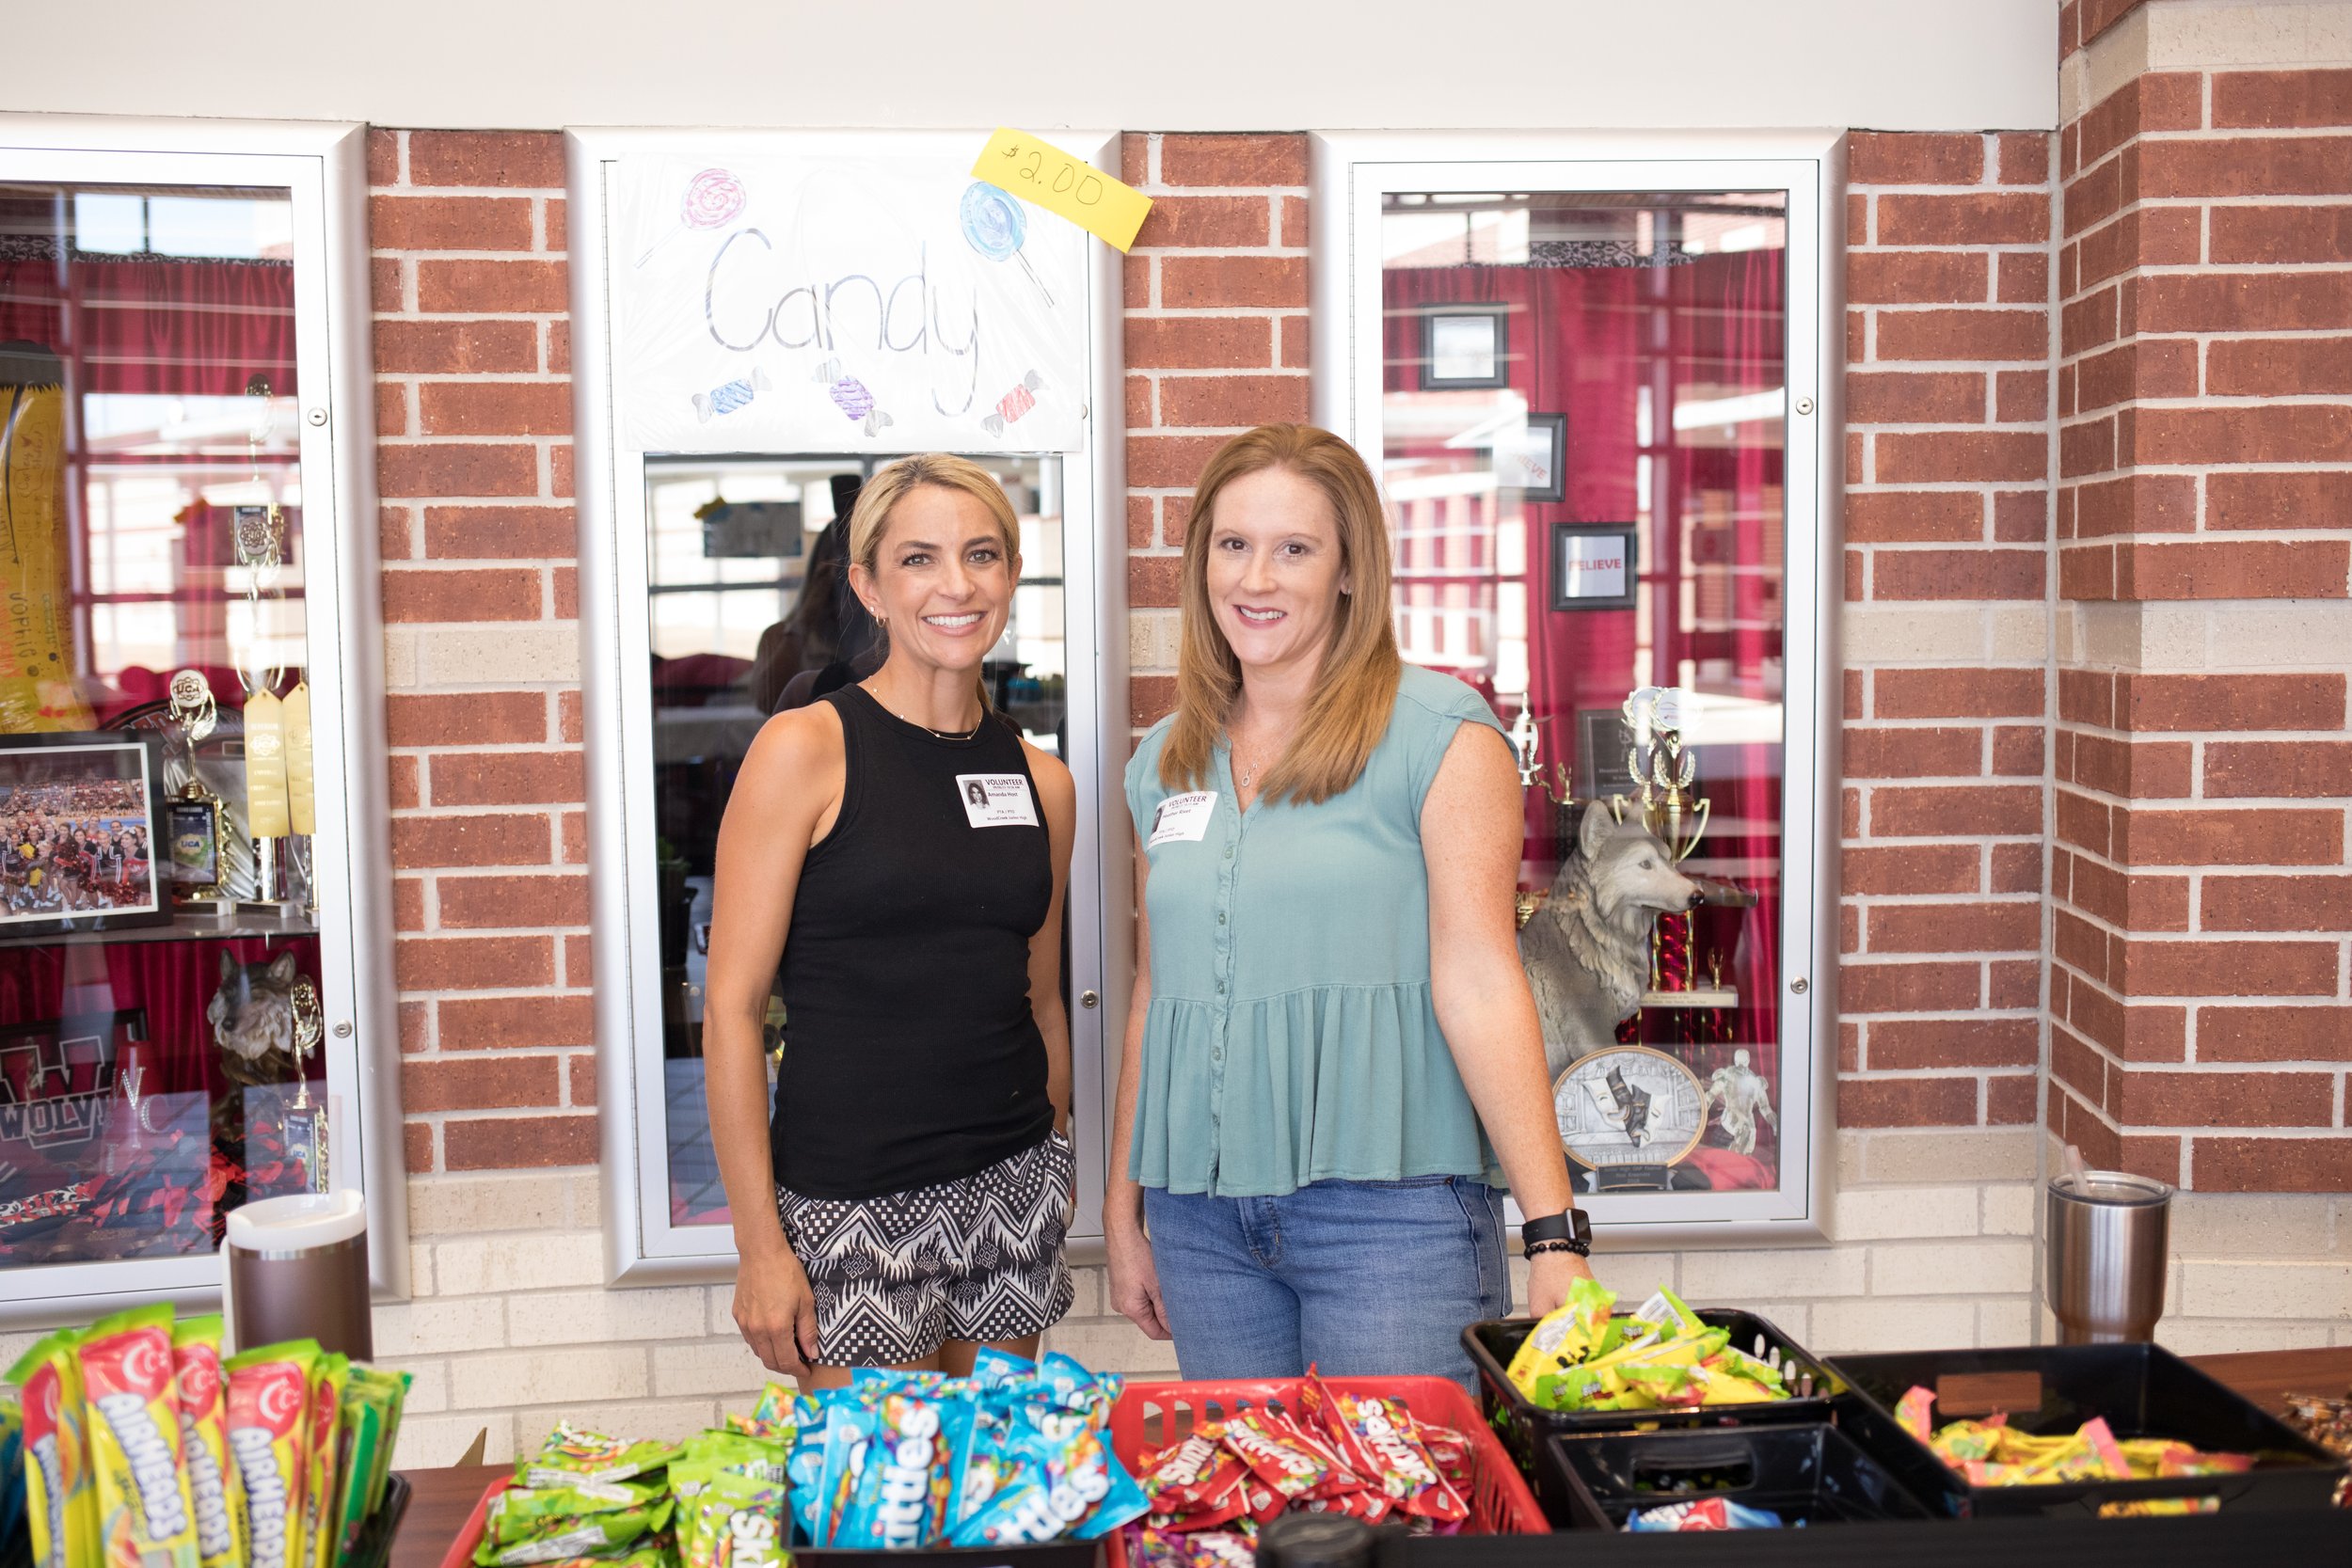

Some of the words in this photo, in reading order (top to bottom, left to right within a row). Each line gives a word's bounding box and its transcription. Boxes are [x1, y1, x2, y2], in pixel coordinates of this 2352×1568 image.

[1001, 144, 1104, 206] $2.00
[705, 228, 979, 418] Candy
[1168, 796, 1207, 807] VOLUNTEER
[97, 1391, 187, 1541] AIRHEADS
